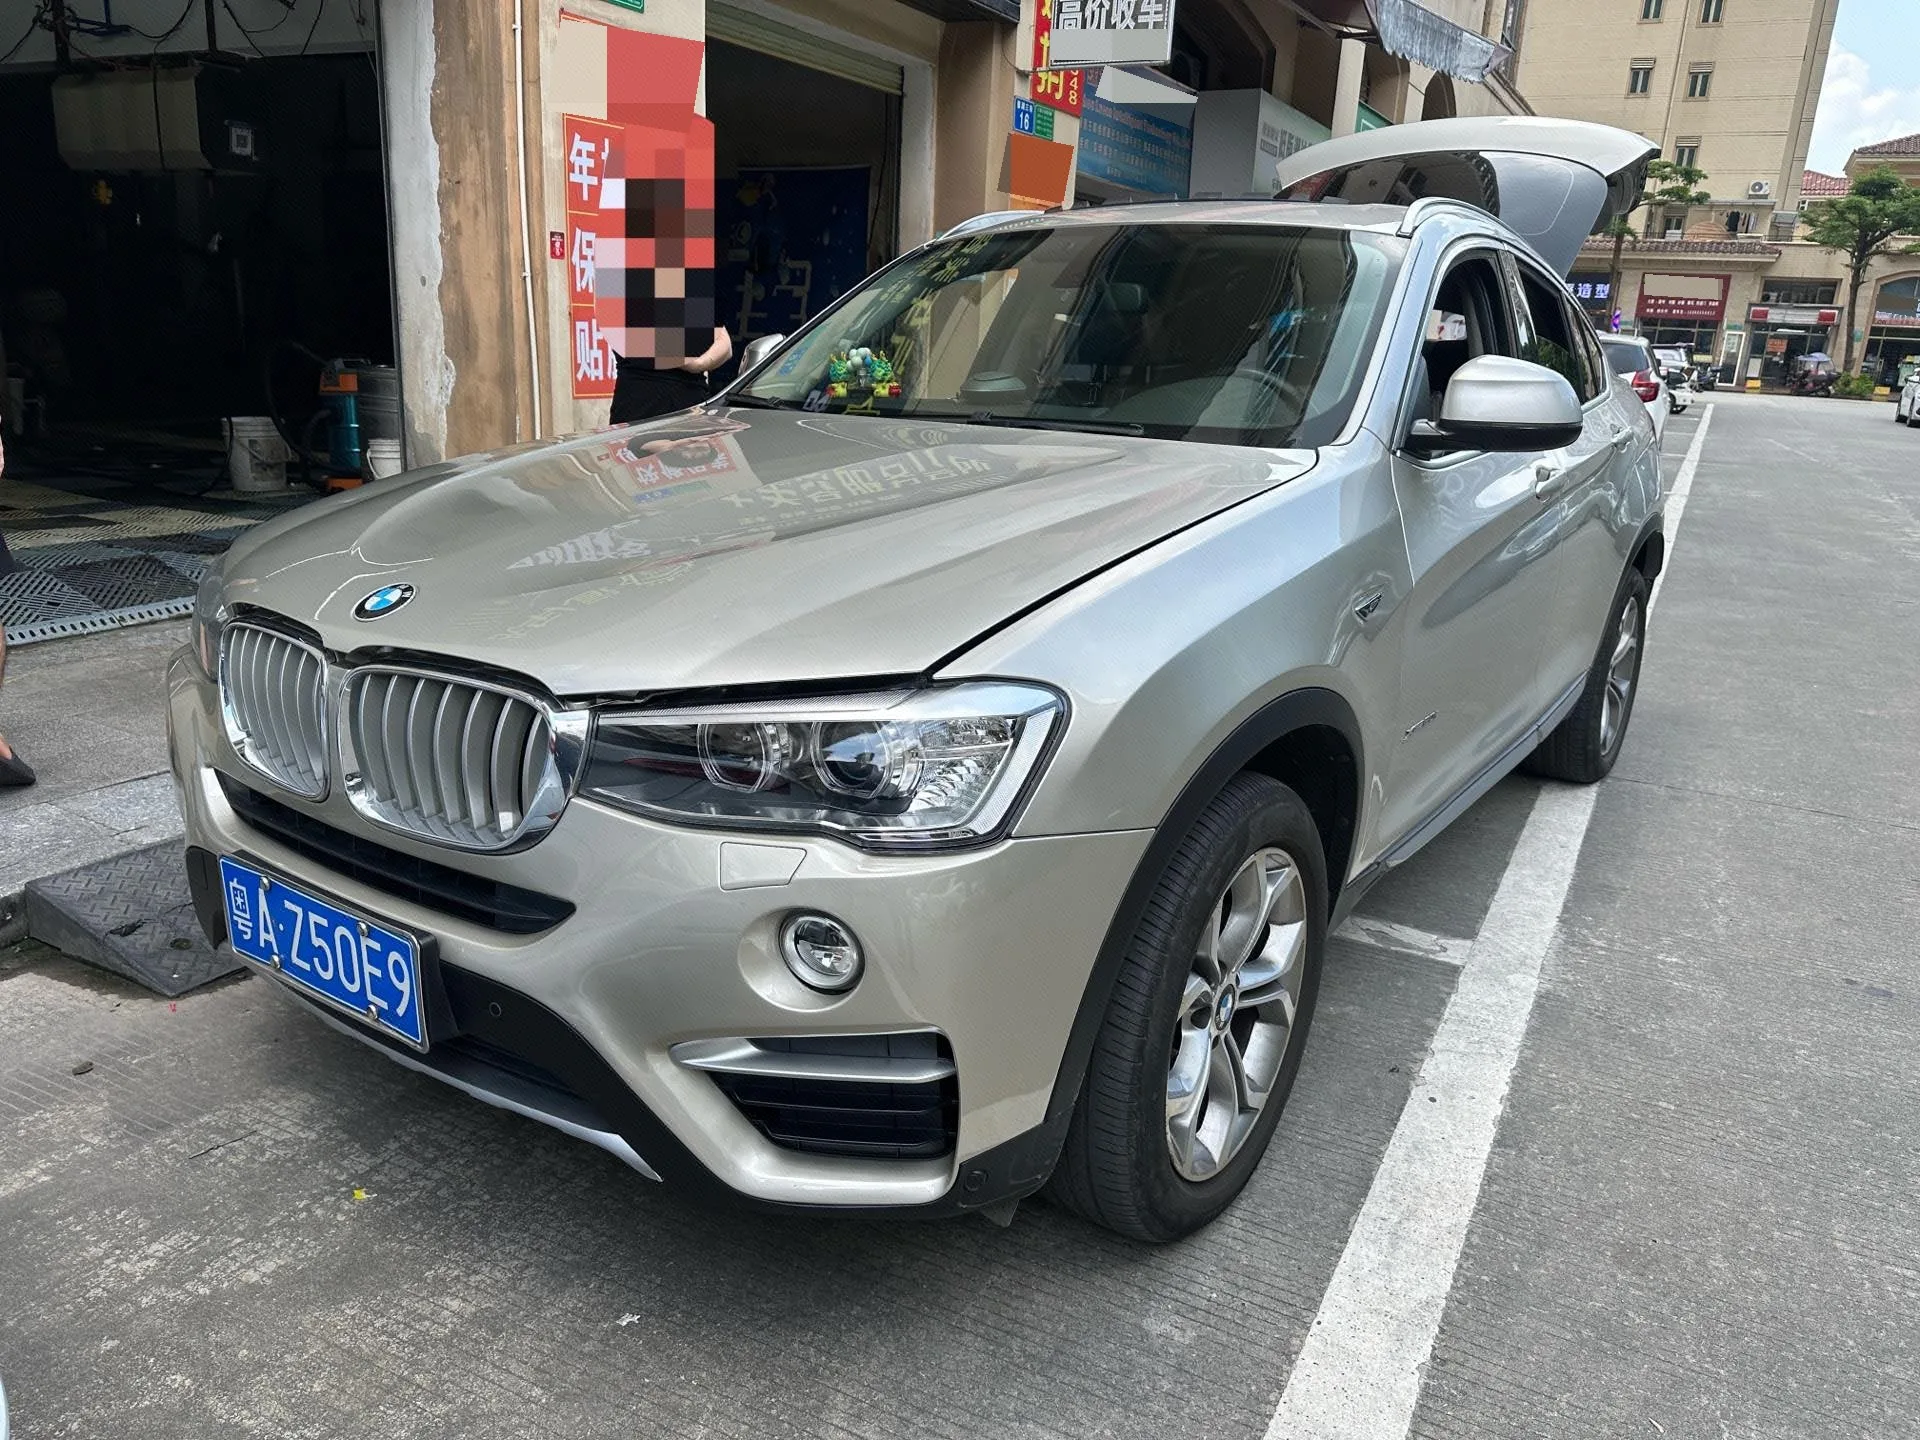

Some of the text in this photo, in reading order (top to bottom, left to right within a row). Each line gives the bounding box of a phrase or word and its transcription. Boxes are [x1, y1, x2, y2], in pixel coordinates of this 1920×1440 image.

[1059, 0, 1164, 29] 高价收车
[1020, 111, 1030, 130] 16
